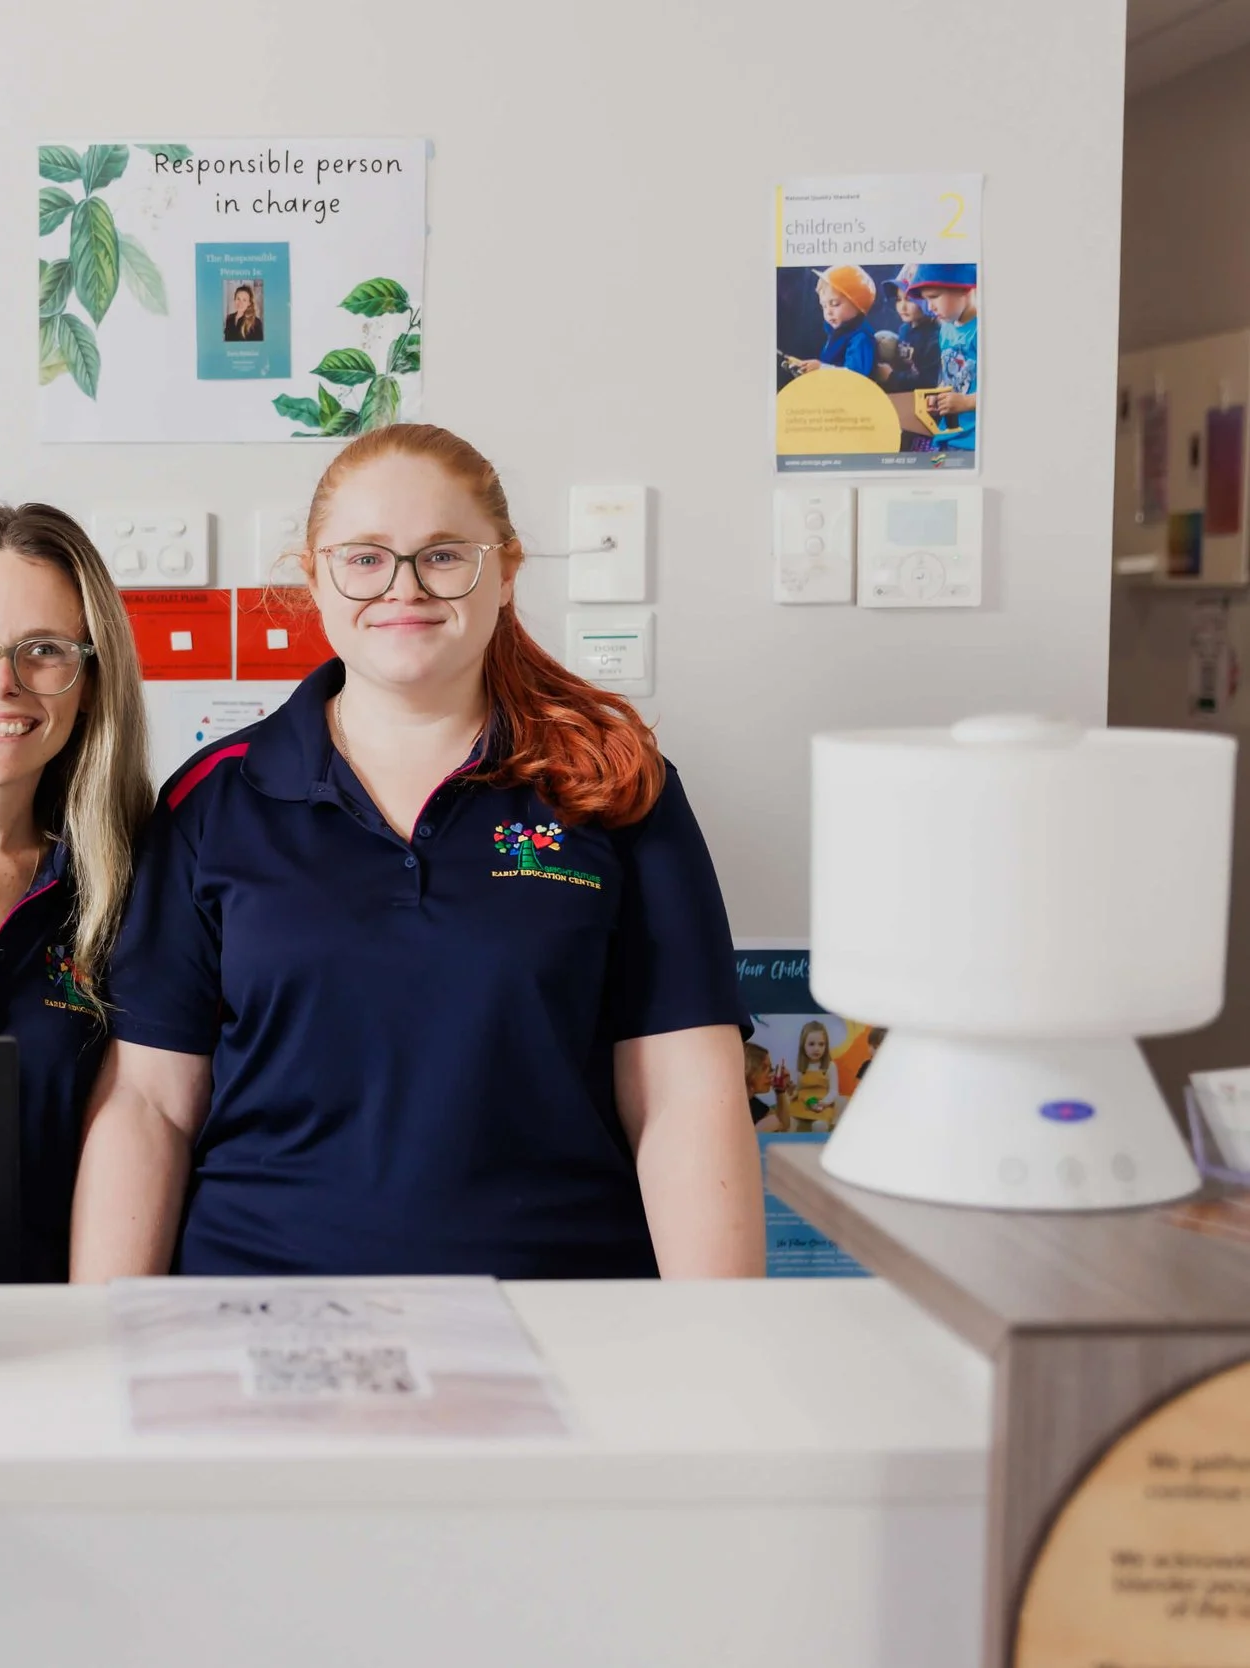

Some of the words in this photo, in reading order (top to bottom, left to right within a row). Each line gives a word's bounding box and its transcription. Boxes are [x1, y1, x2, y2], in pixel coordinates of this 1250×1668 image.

[154, 149, 304, 185] Responsible
[317, 155, 403, 185] person
[215, 192, 240, 214] in
[252, 189, 341, 224] charge
[938, 192, 968, 239] 2
[785, 218, 866, 235] children's
[785, 237, 839, 255] health
[842, 237, 874, 254] and
[878, 235, 928, 256] safety
[491, 869, 519, 877] EARLY
[520, 869, 567, 882] EDUCATION
[736, 958, 766, 981] Your
[44, 998, 67, 1009] EARLY
